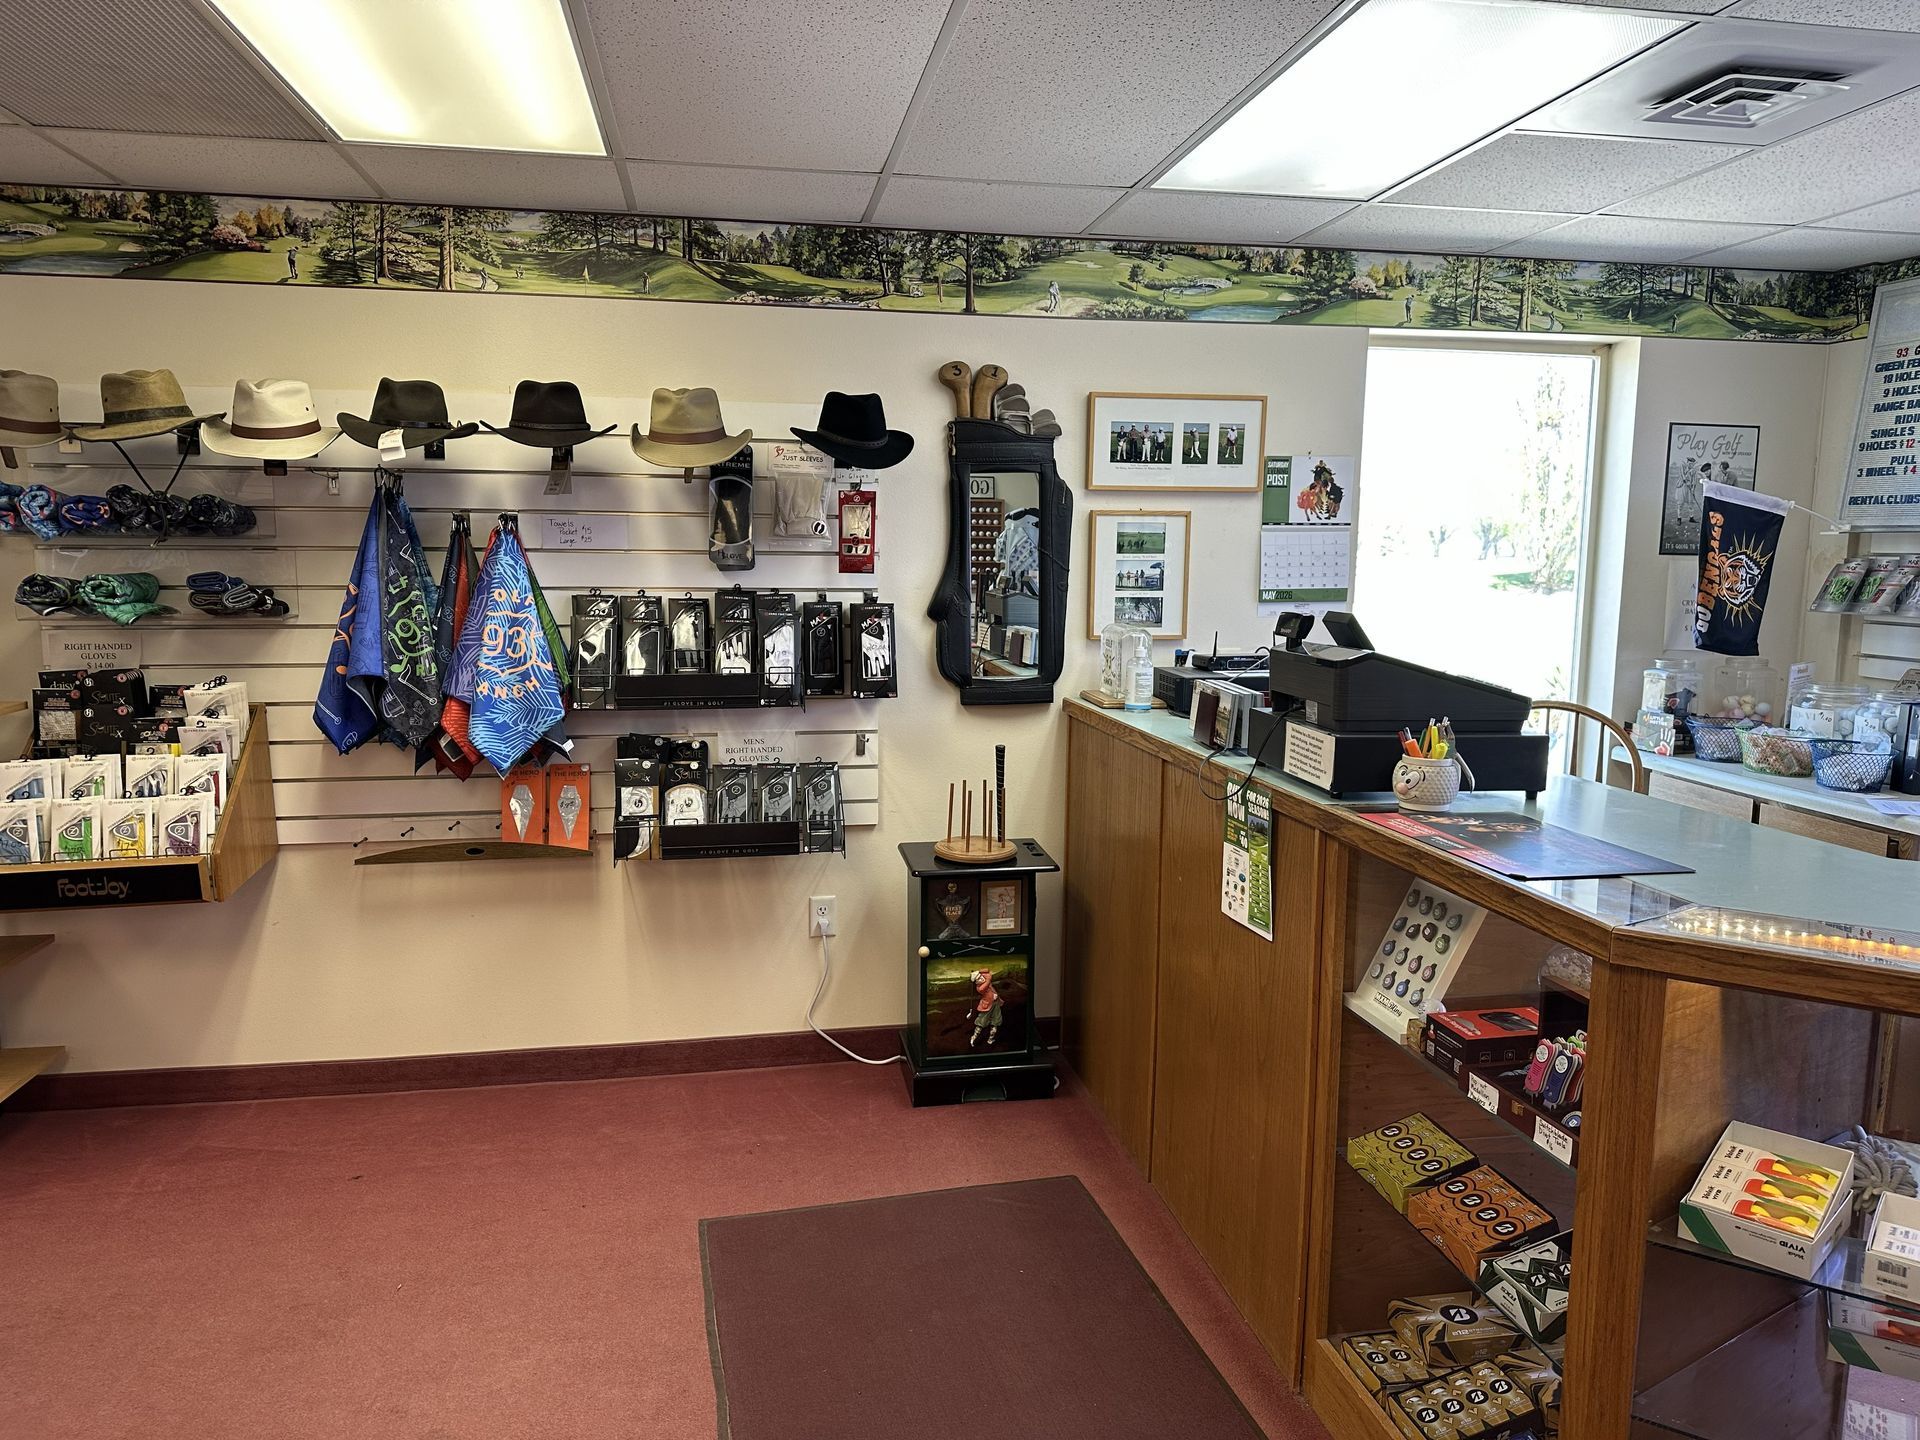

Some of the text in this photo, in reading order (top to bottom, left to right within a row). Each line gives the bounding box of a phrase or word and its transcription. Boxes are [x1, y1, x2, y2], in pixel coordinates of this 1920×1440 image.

[1896, 348, 1909, 358] 93
[951, 364, 962, 376] 3
[991, 366, 999, 378] 1
[1875, 360, 1904, 372] GREEN
[1884, 374, 1894, 384] 18
[1882, 388, 1890, 398] 9
[1874, 400, 1906, 413] RANGE
[1870, 426, 1916, 438] SINGLES
[1677, 432, 1744, 460] Play Golf
[1890, 455, 1916, 465] PULL
[1857, 468, 1864, 478] 3
[1865, 466, 1898, 477] WHEEL
[1266, 474, 1288, 486] POST
[547, 518, 574, 528] Towels
[560, 524, 592, 536] Pocket $15
[560, 538, 578, 547] Large
[1262, 590, 1292, 600] MAY 2026
[482, 624, 526, 658] 93
[1227, 782, 1243, 804] BUY
[1246, 790, 1256, 804] FOR
[1228, 798, 1245, 822] NOW
[1779, 1240, 1806, 1253] VIVID
